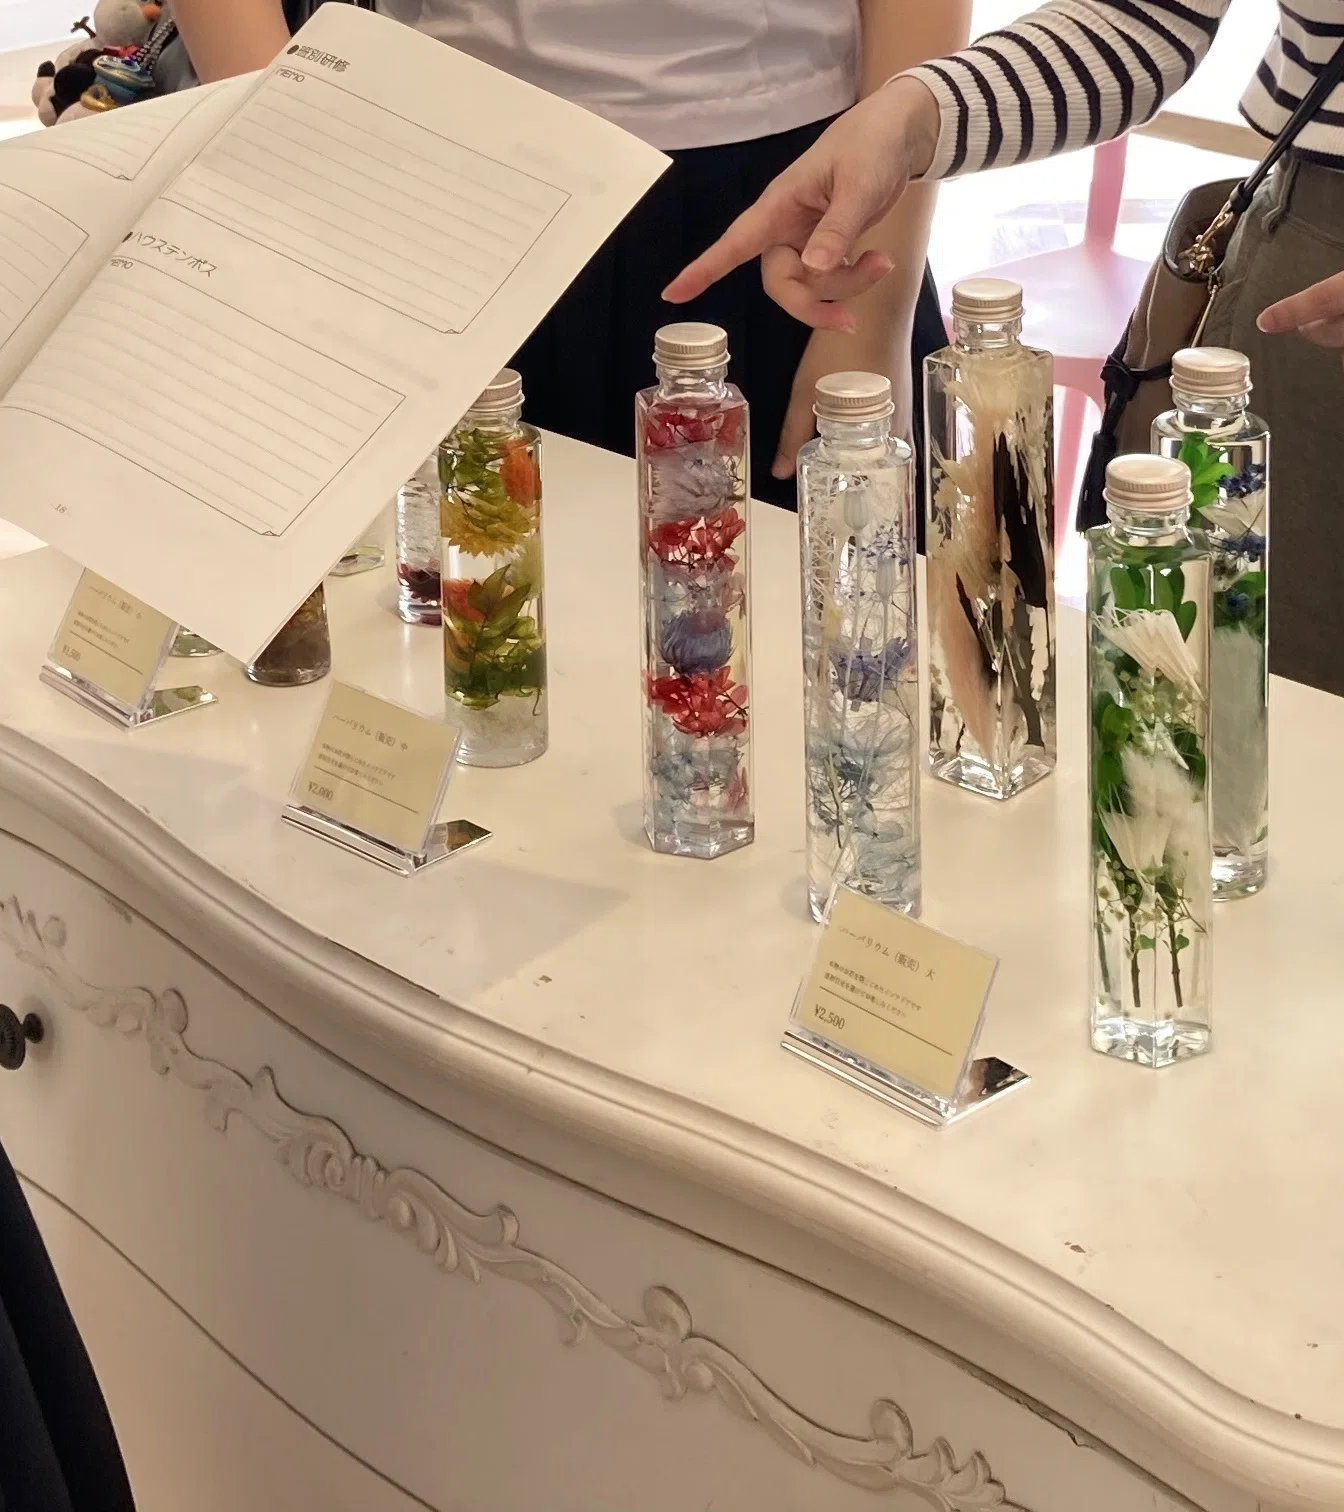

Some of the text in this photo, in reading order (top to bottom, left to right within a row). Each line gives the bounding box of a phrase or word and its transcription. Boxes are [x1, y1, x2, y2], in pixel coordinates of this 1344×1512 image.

[129, 232, 217, 277] ハウステンボス
[814, 1003, 847, 1031] ¥2,500
